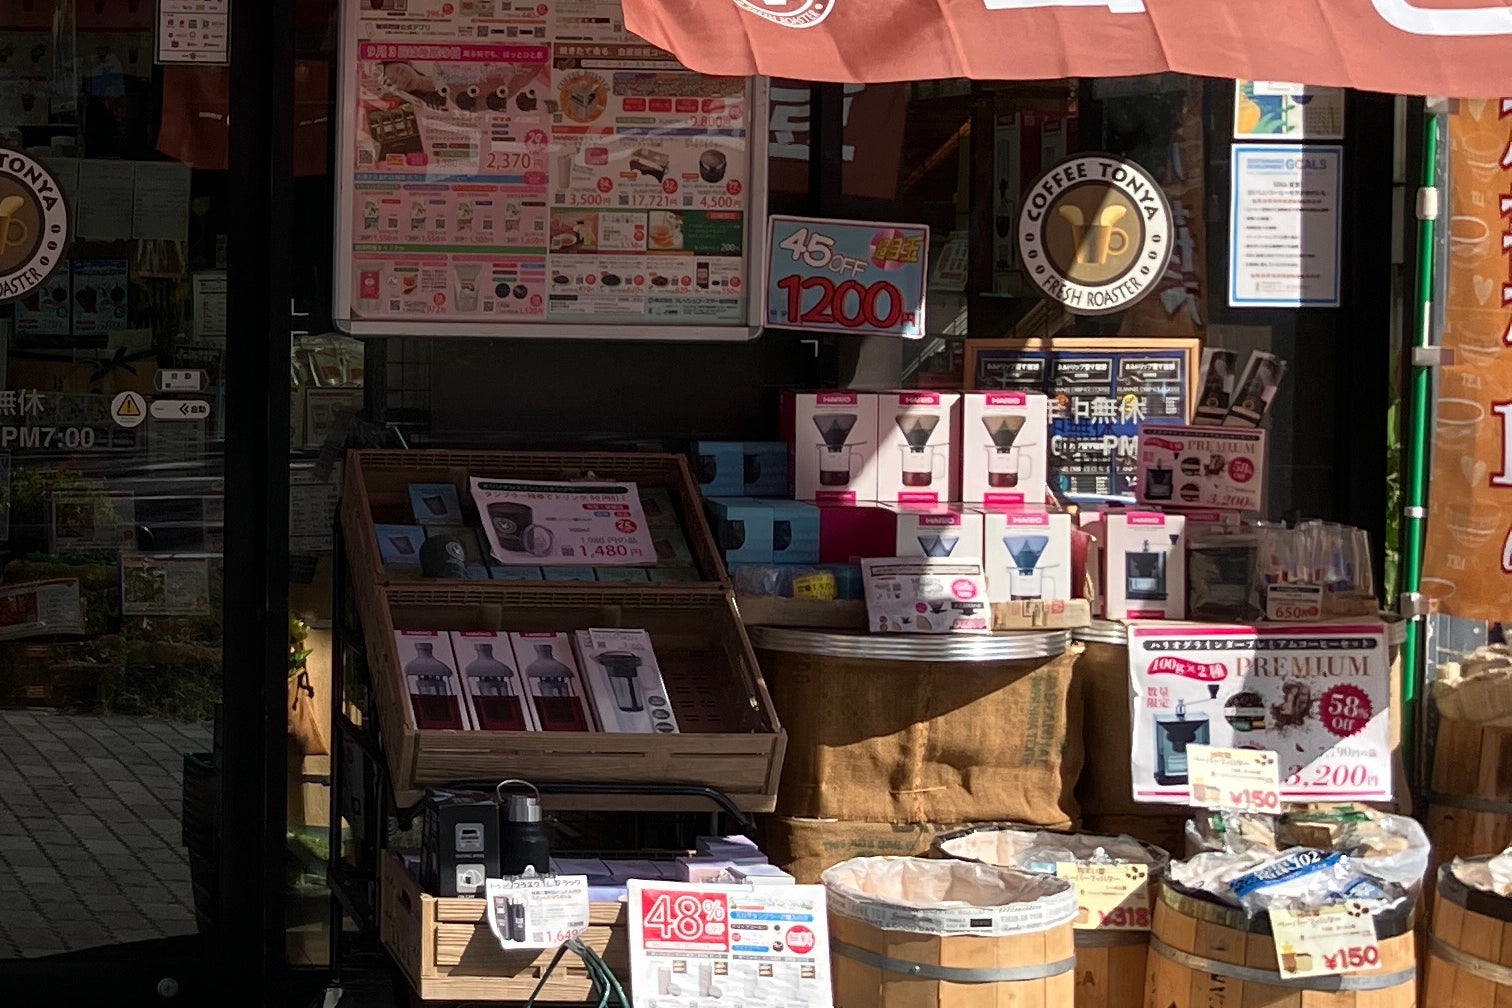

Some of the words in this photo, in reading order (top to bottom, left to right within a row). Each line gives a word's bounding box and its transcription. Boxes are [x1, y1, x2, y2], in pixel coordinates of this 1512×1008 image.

[487, 153, 544, 169] 2,370円
[1285, 158, 1327, 170] GOALS
[569, 193, 612, 206] 3,500円
[699, 195, 742, 208] 4,500円
[1027, 162, 1088, 223] COFFEE
[1098, 162, 1159, 221] TONYA
[779, 227, 836, 267] 45
[828, 255, 868, 278] OFF
[1042, 275, 1082, 306] FRESH
[1087, 276, 1143, 307] ROASTER
[1187, 440, 1256, 454] PREMIUM
[579, 544, 642, 559] 1,480円
[1148, 638, 1372, 650] ハリオグラインダープレミアムコーヒーセット
[1235, 656, 1371, 678] PREMIUM
[1228, 788, 1278, 809] ¥150
[644, 894, 726, 940] 48%
[1097, 906, 1150, 927] ¥318
[704, 922, 726, 936] OFF
[1322, 945, 1379, 971] ¥150
